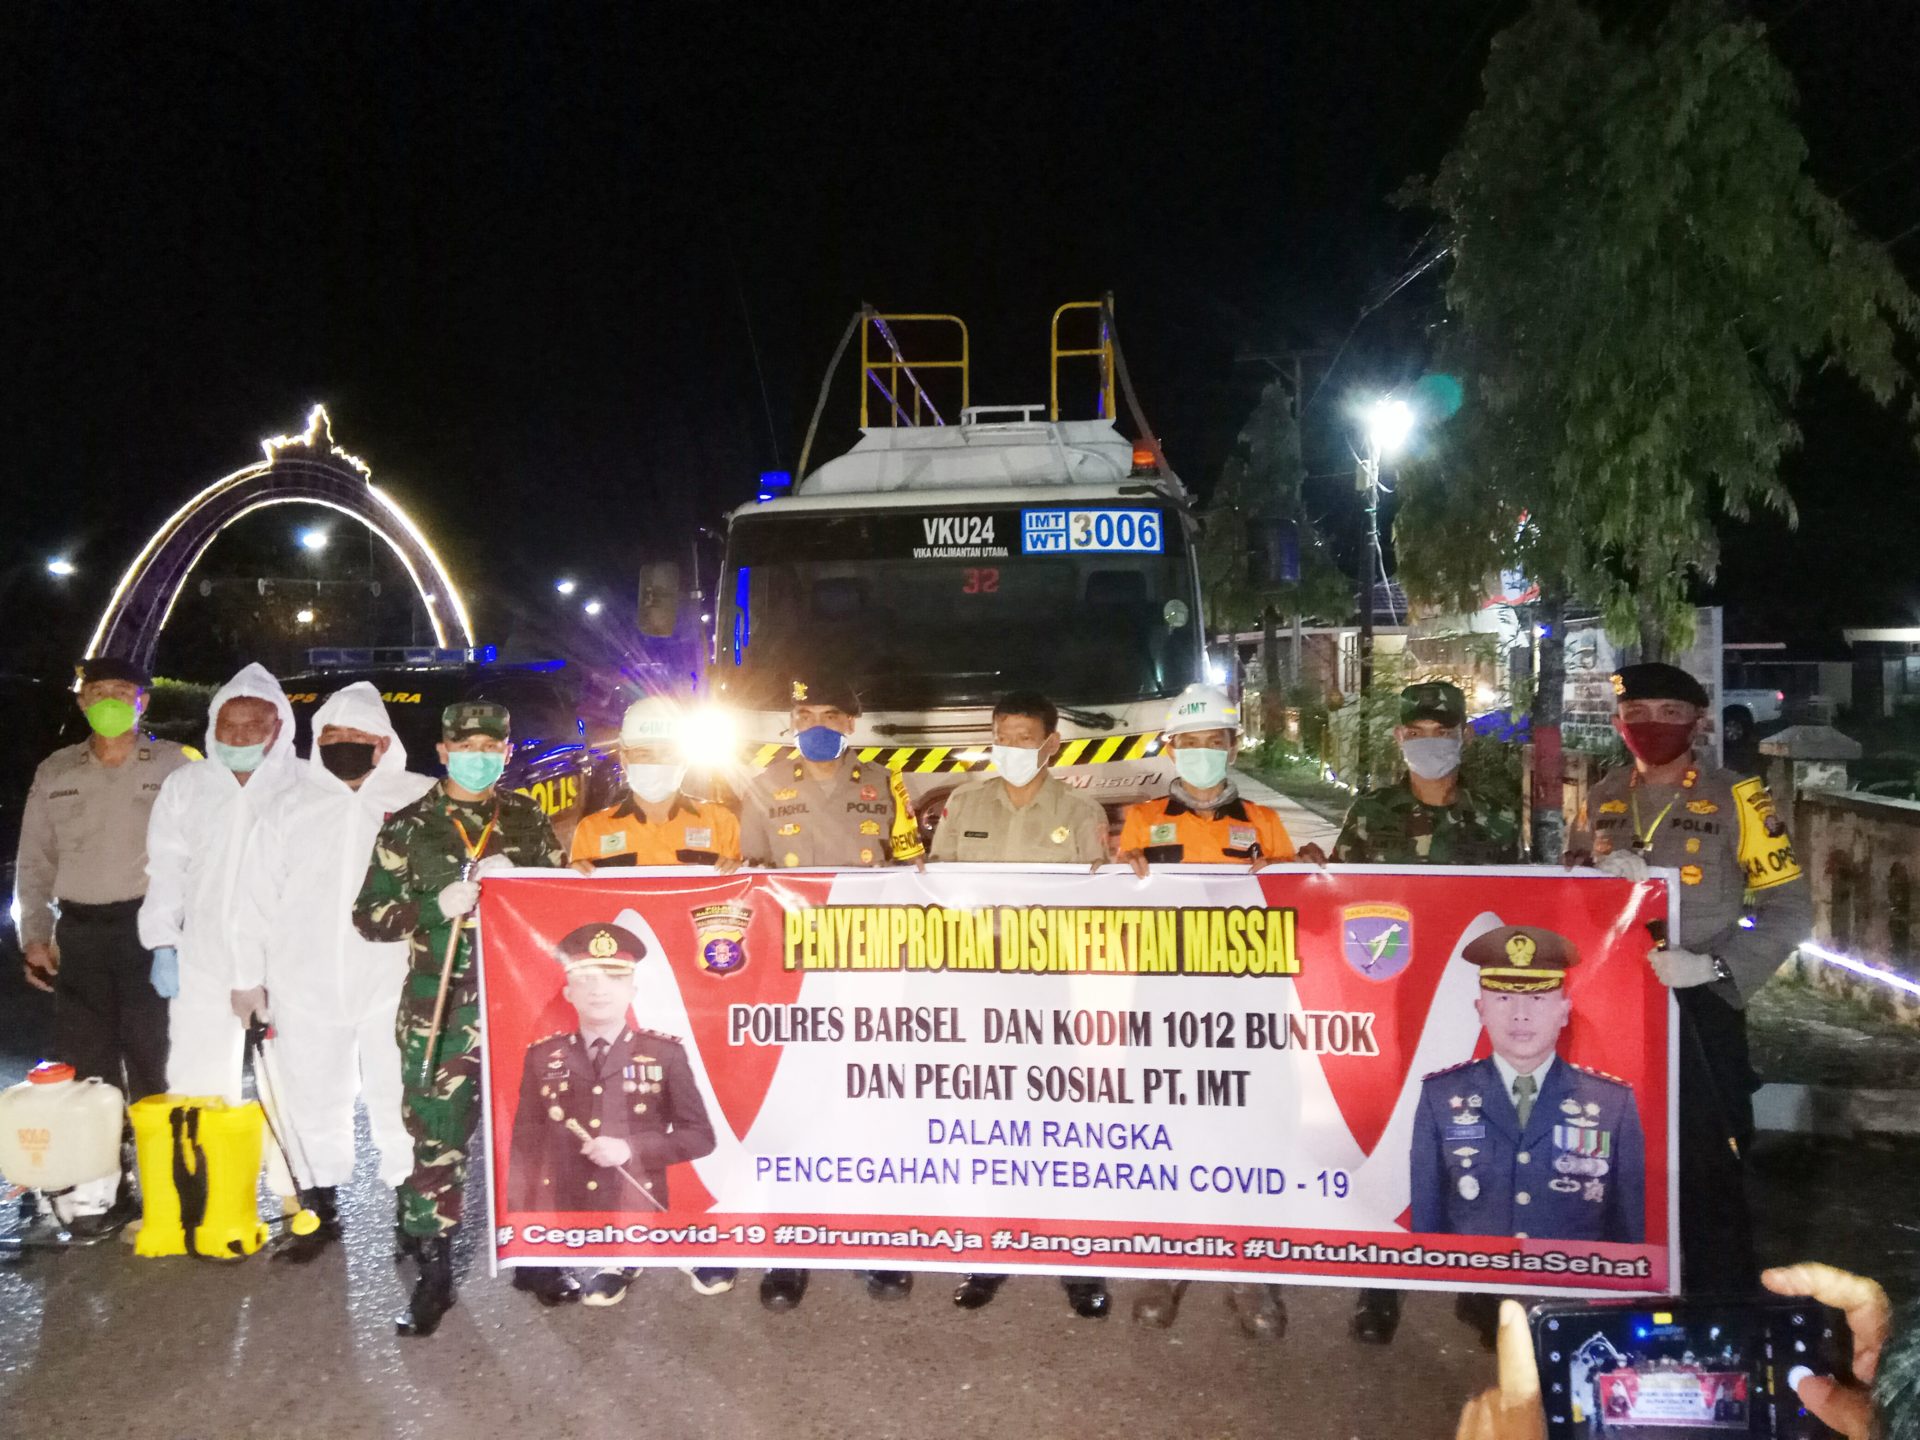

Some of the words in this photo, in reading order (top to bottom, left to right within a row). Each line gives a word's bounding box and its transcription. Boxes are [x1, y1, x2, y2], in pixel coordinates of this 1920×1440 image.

[923, 515, 995, 545] VKU24
[1028, 514, 1063, 528] IMT
[1073, 513, 1158, 548] 3006
[913, 547, 932, 558] VIKA
[932, 547, 981, 558] KALIMANTAN
[982, 547, 1008, 557] UTAMA
[1029, 533, 1063, 549] WT
[1187, 702, 1207, 714] IMT
[847, 803, 887, 815] POLRI
[1673, 818, 1719, 835] POLRI
[783, 907, 995, 971] PENYEMPROTAN
[1002, 907, 1177, 974] DISINFEKTAN
[1182, 908, 1300, 975] MASSAL
[731, 1006, 845, 1043] POLRES
[854, 1006, 967, 1043] BARSEL
[984, 1007, 1044, 1045] DAN
[1053, 1009, 1153, 1047] KODIM
[1163, 1011, 1236, 1049] 1012
[1245, 1012, 1376, 1054] BUNTOK
[846, 1063, 905, 1099] DAN
[914, 1064, 1018, 1101] PEGIAT
[1026, 1065, 1135, 1104] SOSIAL
[1143, 1068, 1188, 1106] PT.
[1196, 1069, 1252, 1107] IMT
[928, 1119, 1031, 1147] DALAM
[1042, 1121, 1173, 1150] RANGKA
[756, 1156, 960, 1185] PENCEGAHAN
[972, 1159, 1179, 1193] PENYEBARAN
[1189, 1165, 1286, 1195] COVID
[1316, 1169, 1350, 1199] 19
[522, 1224, 767, 1248] CegahCovid-19
[772, 1226, 983, 1253] #DirumahAja
[990, 1230, 1236, 1257] #JanganMudik
[1243, 1238, 1650, 1278] #UntukIndonesiaSehat
